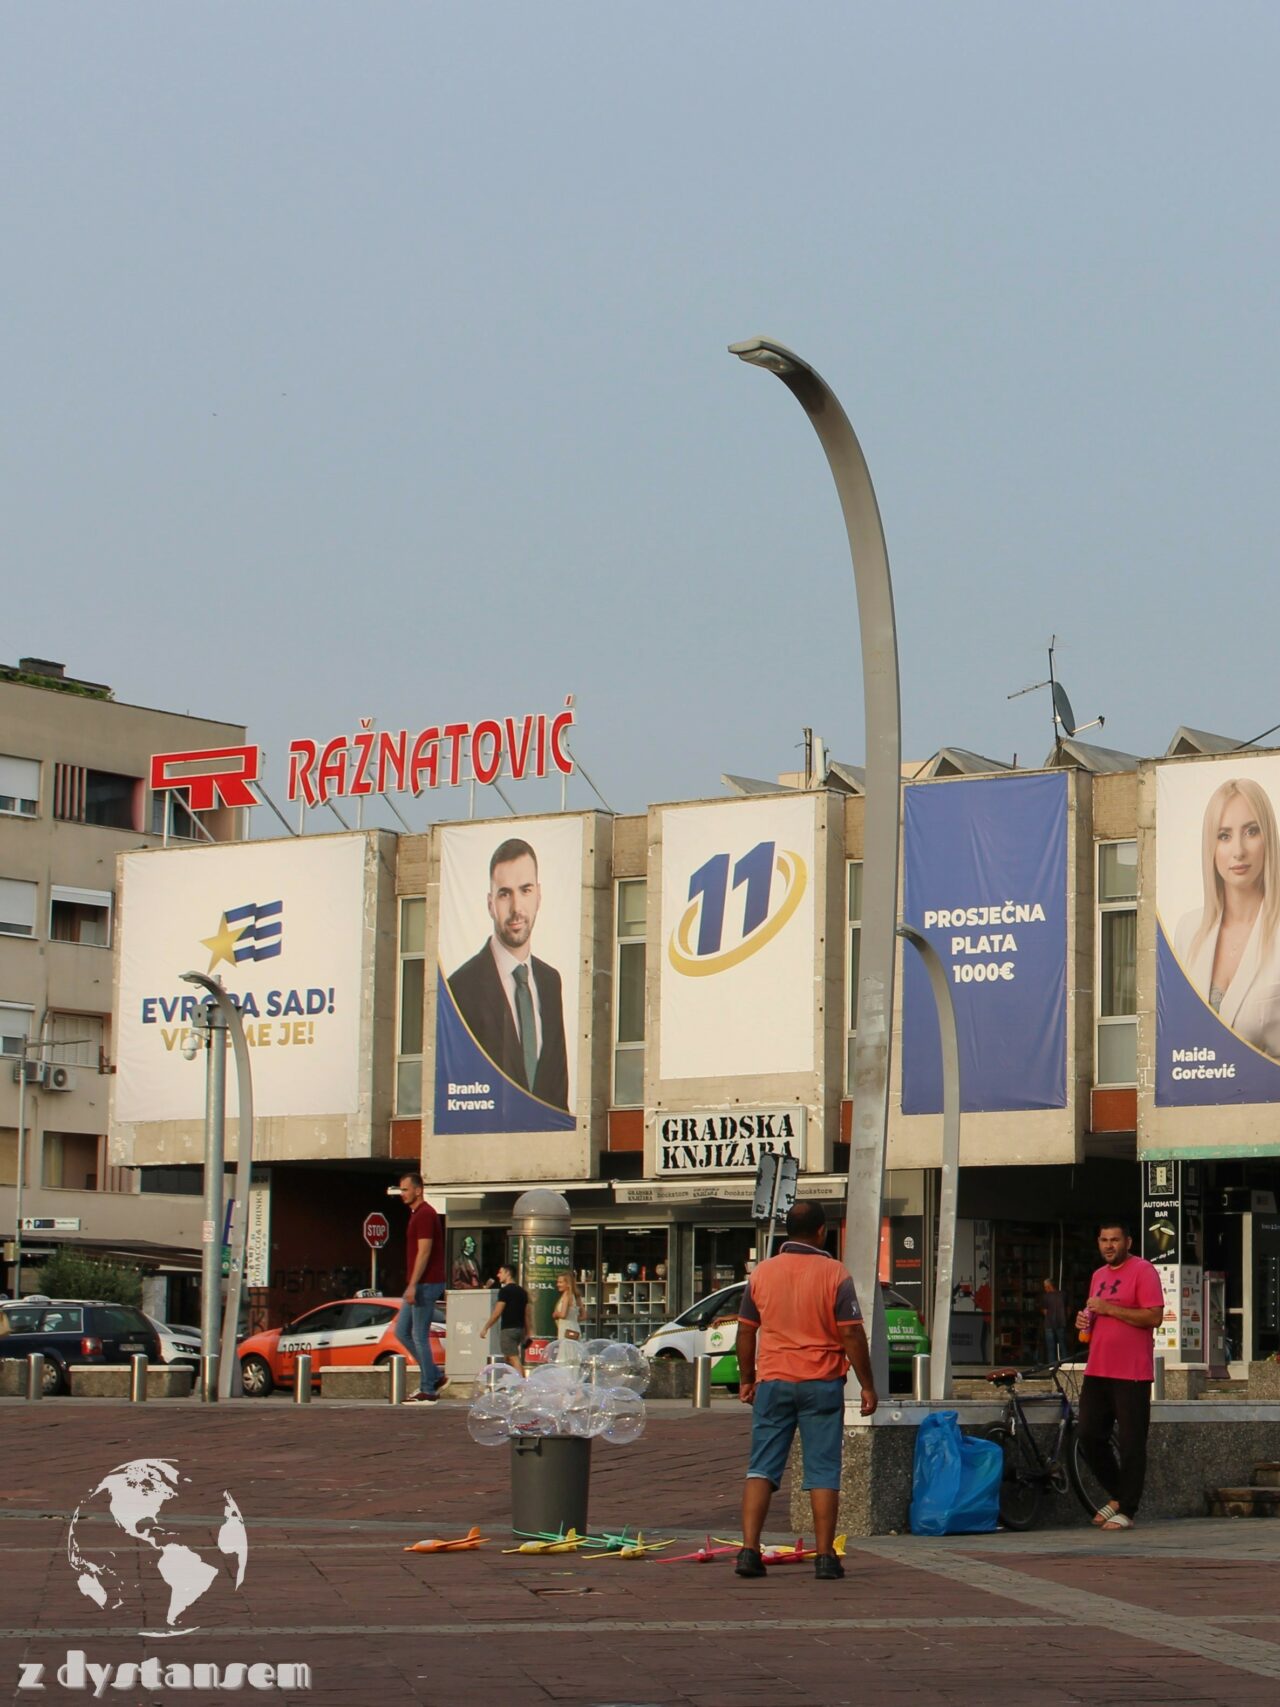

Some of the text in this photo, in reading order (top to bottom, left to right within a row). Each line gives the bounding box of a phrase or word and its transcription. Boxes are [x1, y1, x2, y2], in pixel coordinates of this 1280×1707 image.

[287, 694, 576, 808] RAŽNATOVIĆ
[688, 841, 776, 956] 11
[924, 901, 1046, 929] PROSJEČNA
[951, 934, 1018, 955] PLATA
[953, 962, 1015, 983] 1000€
[142, 987, 335, 1024] EVRA SAD!
[277, 1021, 314, 1046] JE!
[1172, 1046, 1216, 1062] Maida
[1171, 1063, 1236, 1080] Gorčević
[448, 1081, 490, 1095] Branko
[447, 1099, 495, 1111] Krvavac
[662, 1113, 795, 1142] GRADSKA
[367, 1224, 386, 1237] STOP
[528, 1245, 562, 1255] TENIS
